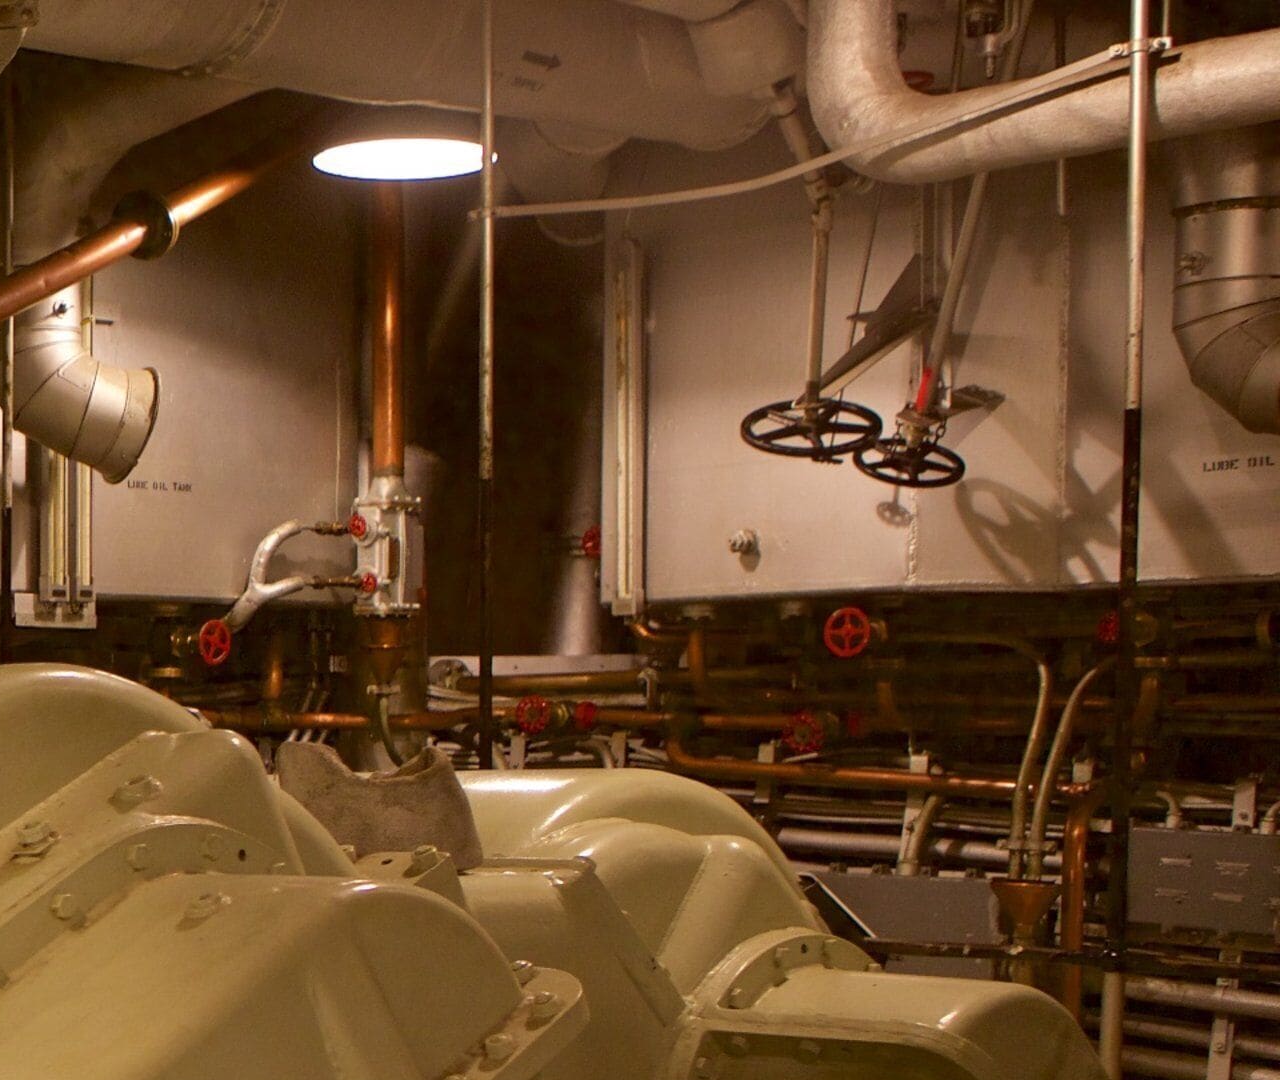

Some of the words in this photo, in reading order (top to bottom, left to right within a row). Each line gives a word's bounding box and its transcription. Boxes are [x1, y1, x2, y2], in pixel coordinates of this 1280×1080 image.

[1203, 459, 1239, 473] LUBE
[1247, 456, 1275, 467] OIL
[153, 481, 168, 491] OIL
[173, 482, 192, 493] TANK
